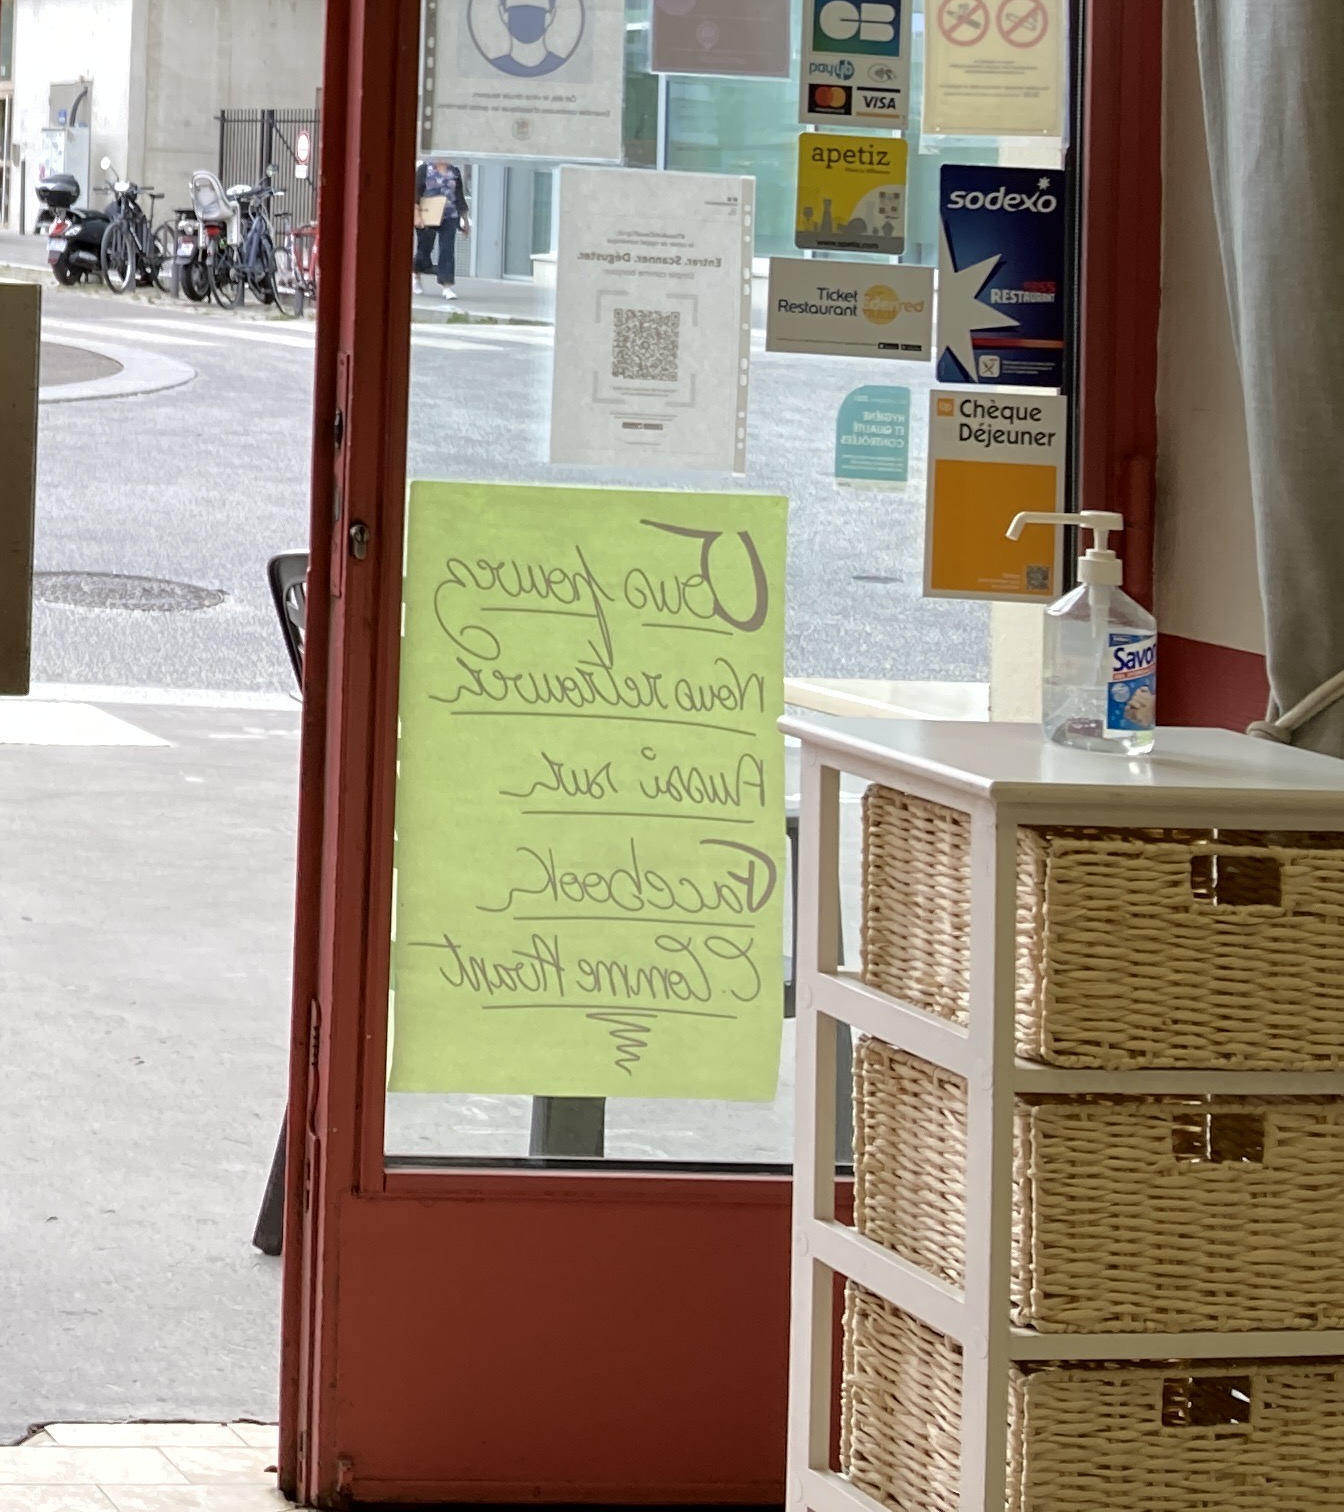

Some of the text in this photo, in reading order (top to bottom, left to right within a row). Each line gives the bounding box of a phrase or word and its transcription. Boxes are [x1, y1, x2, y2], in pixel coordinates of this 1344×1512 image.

[819, 0, 896, 43] CB
[863, 95, 896, 109] VISA
[812, 144, 891, 168] apetiz
[947, 186, 1057, 213] sodexo
[816, 287, 858, 303] Ticket
[990, 288, 1055, 304] RESTAURANT
[778, 299, 858, 317] Restaurant
[960, 399, 1042, 425] Chèque
[959, 423, 1056, 448] Déjeuner
